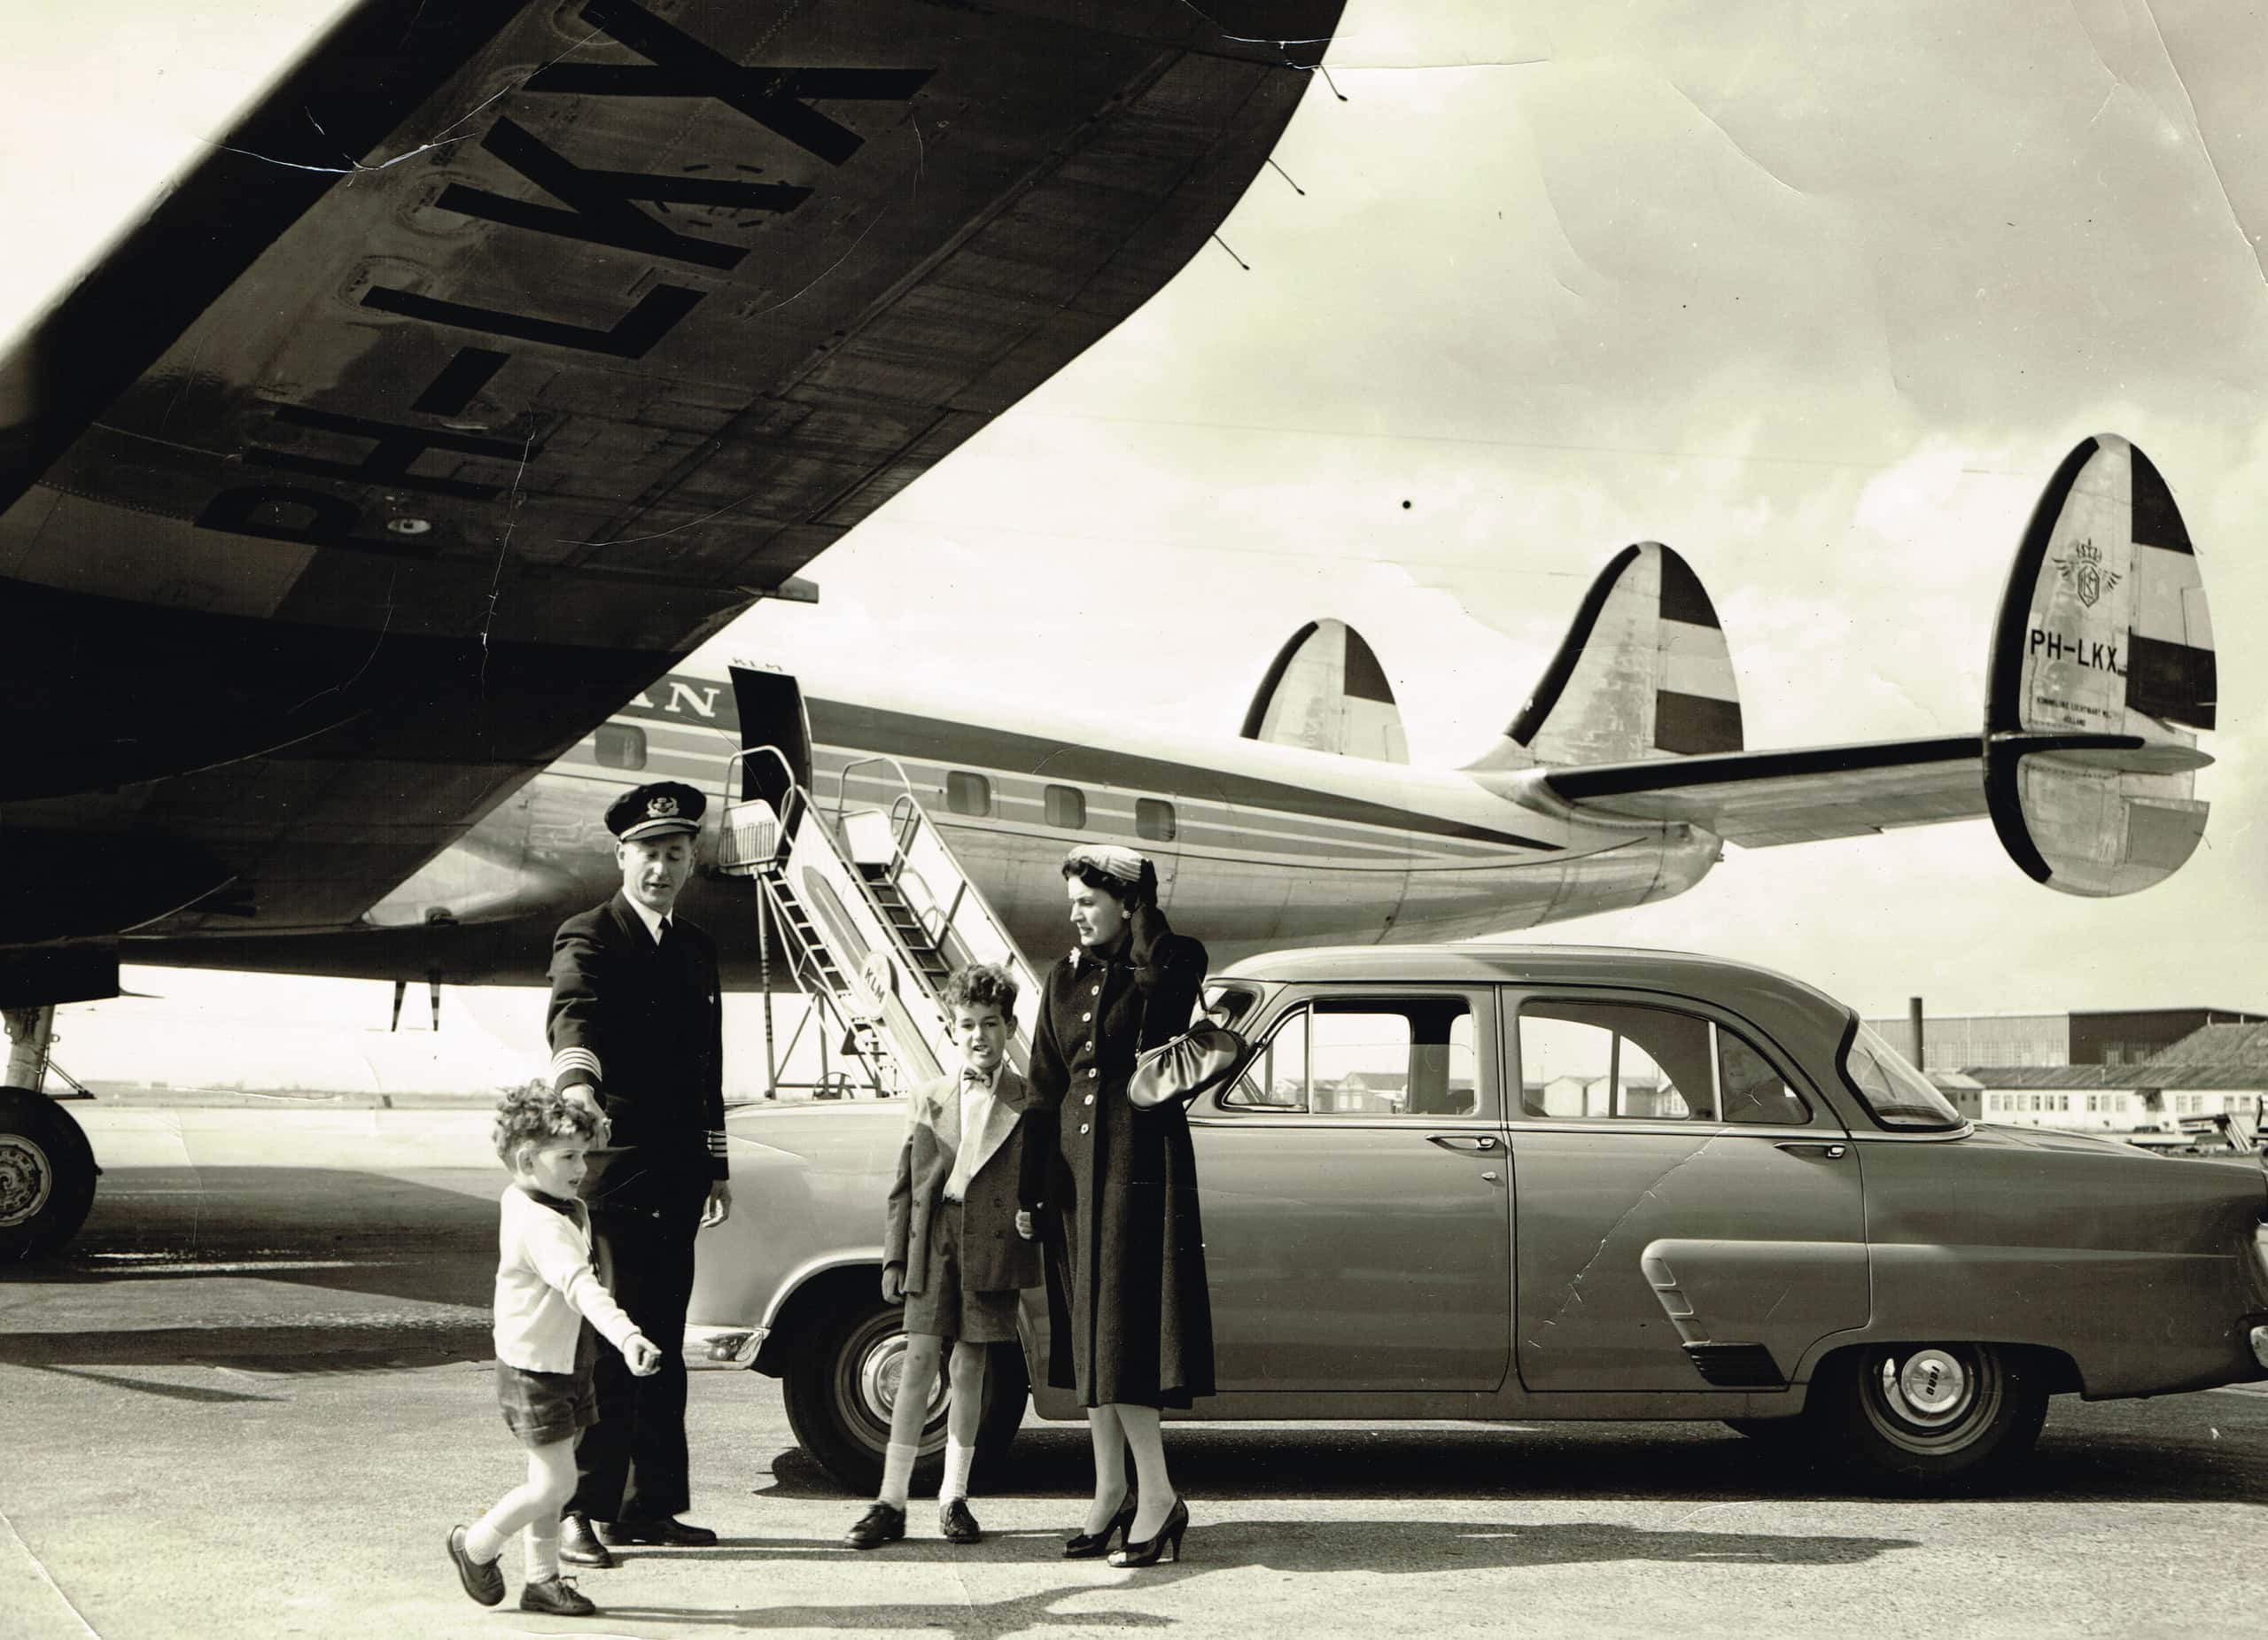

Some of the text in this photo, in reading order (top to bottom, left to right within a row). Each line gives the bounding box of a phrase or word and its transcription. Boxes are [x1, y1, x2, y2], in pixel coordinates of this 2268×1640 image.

[2031, 628, 2117, 673] PH-LKX
[865, 967, 885, 1004] KLM
[1926, 1365, 1940, 1396] FORD
